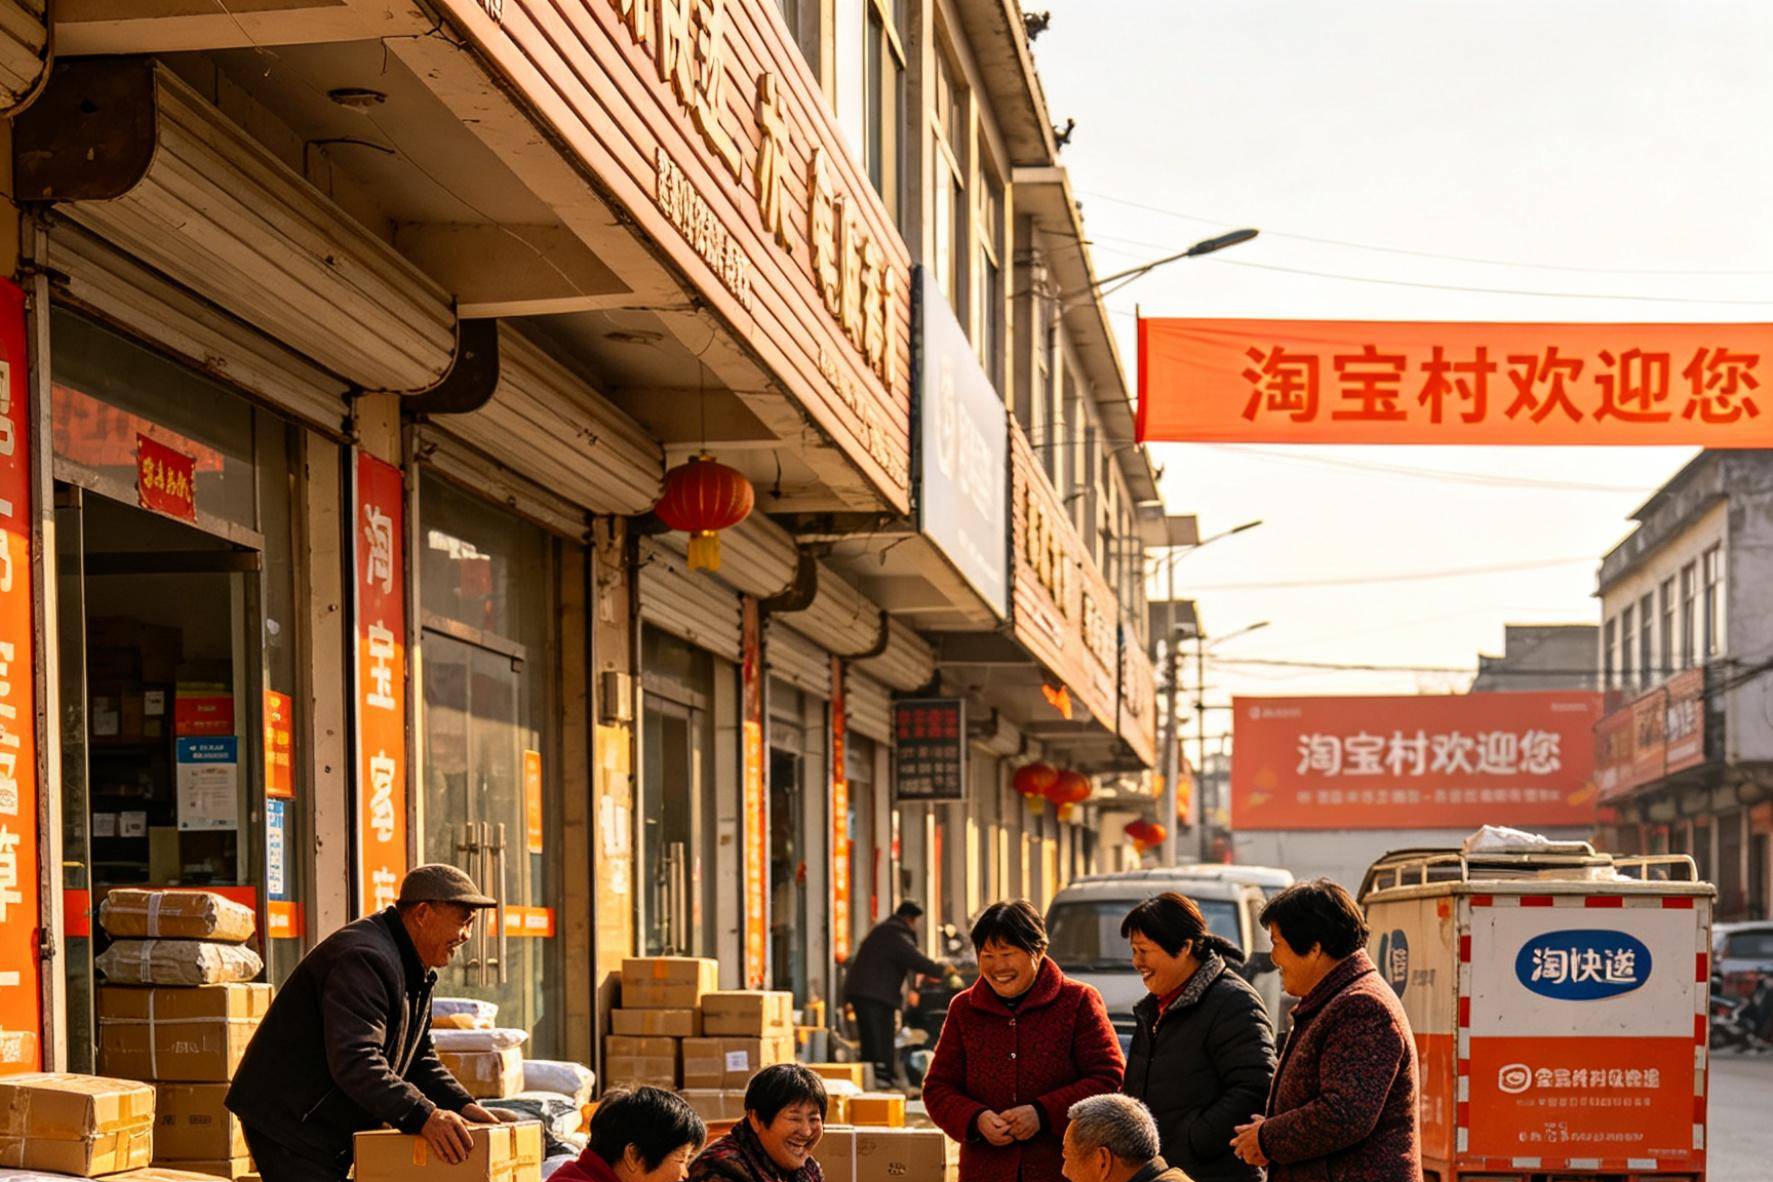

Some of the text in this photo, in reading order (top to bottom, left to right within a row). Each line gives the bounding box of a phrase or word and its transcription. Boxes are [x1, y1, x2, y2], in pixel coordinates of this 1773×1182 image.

[1240, 345, 1761, 424] 淘宝村欢迎您
[1296, 729, 1562, 776] 淘宝村欢迎您
